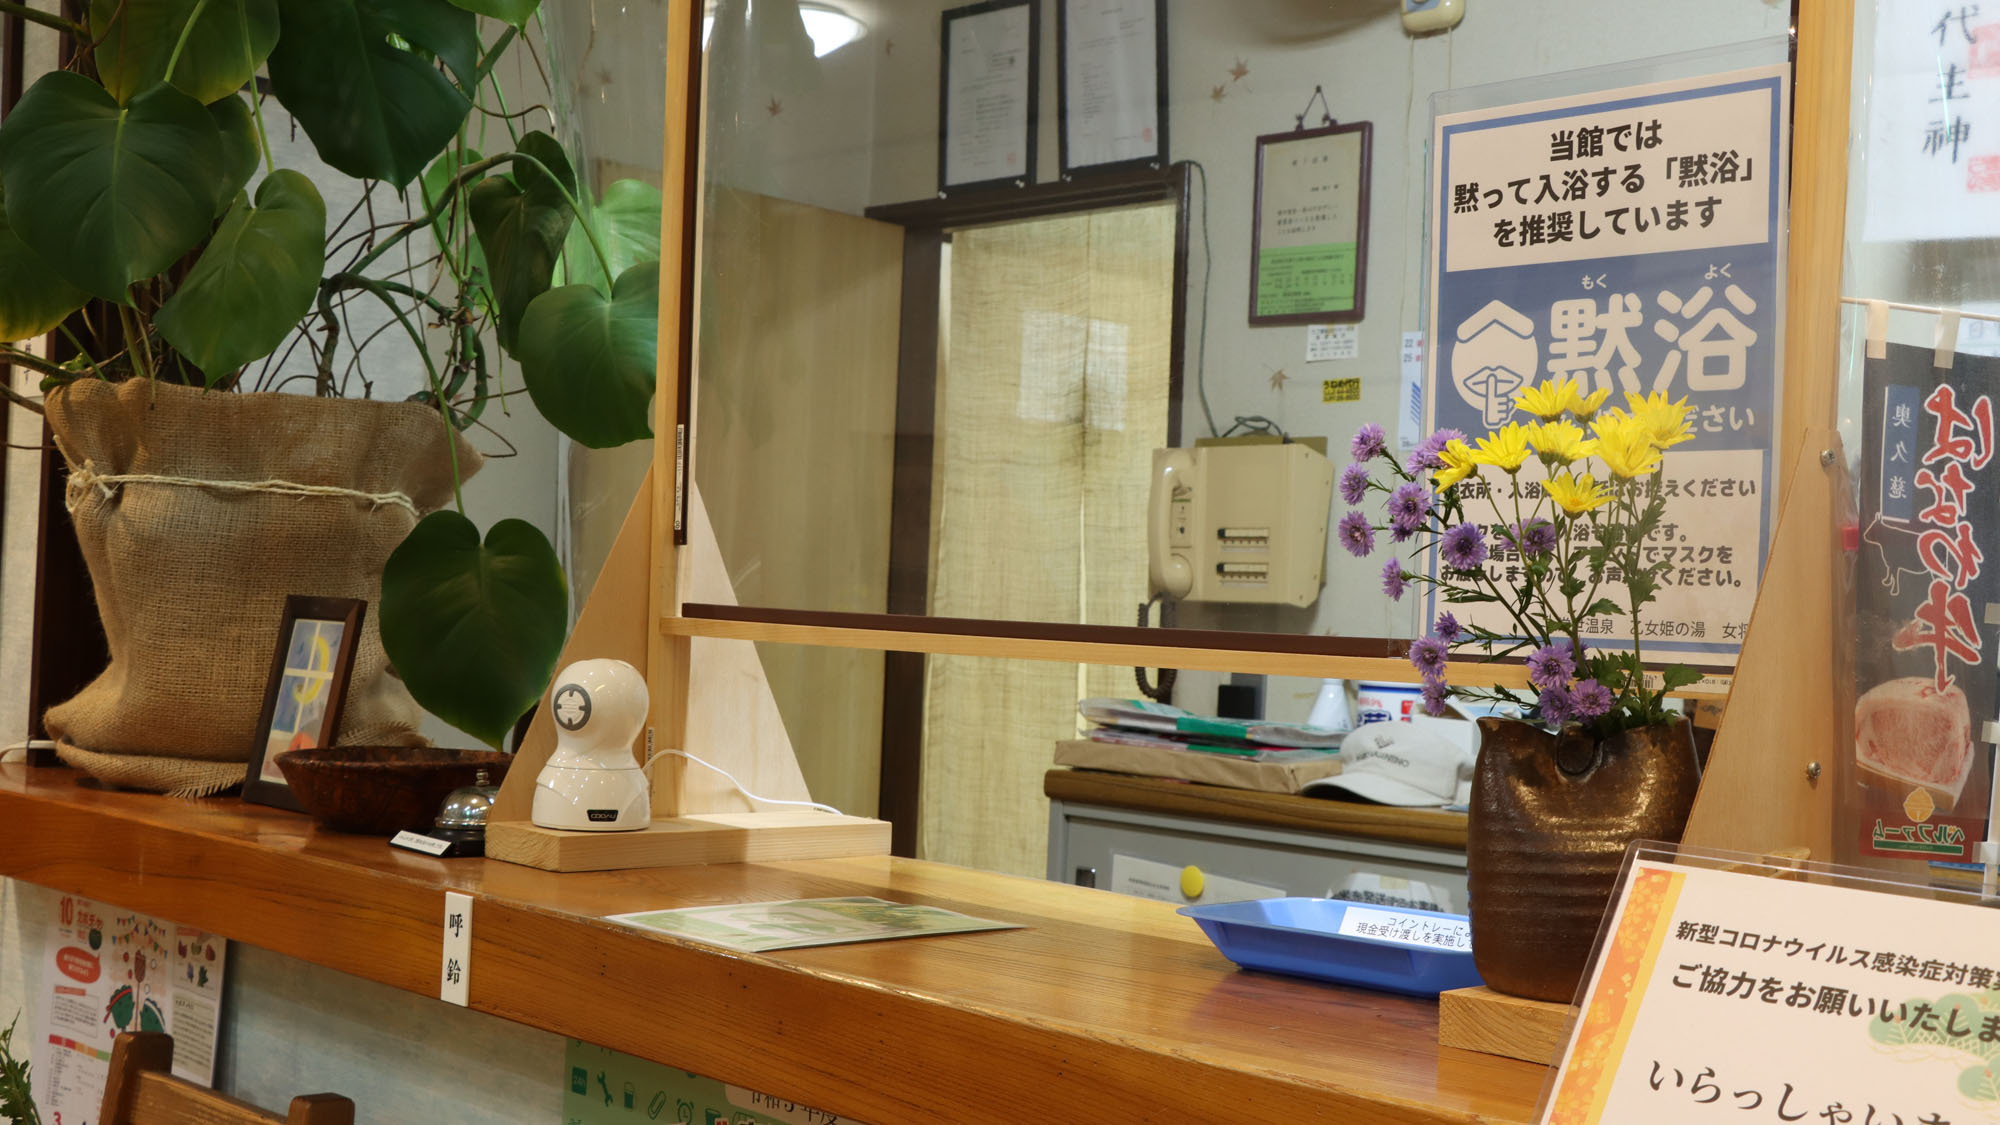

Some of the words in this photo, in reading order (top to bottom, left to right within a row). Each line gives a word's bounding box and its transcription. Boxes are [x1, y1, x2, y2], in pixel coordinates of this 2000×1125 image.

[1550, 119, 1662, 162] 当館では
[1454, 150, 1753, 213] 黙って入浴する「黙浴」
[1493, 196, 1722, 248] を推奨しています
[1581, 274, 1608, 290] もく
[1704, 263, 1732, 280] よく
[1547, 283, 1758, 394] 黙浴
[446, 913, 463, 985] 呼鈴
[1355, 922, 1472, 949] 現金受け渡しを実施し
[1671, 962, 2000, 1043] ご協力をお願いいたしま
